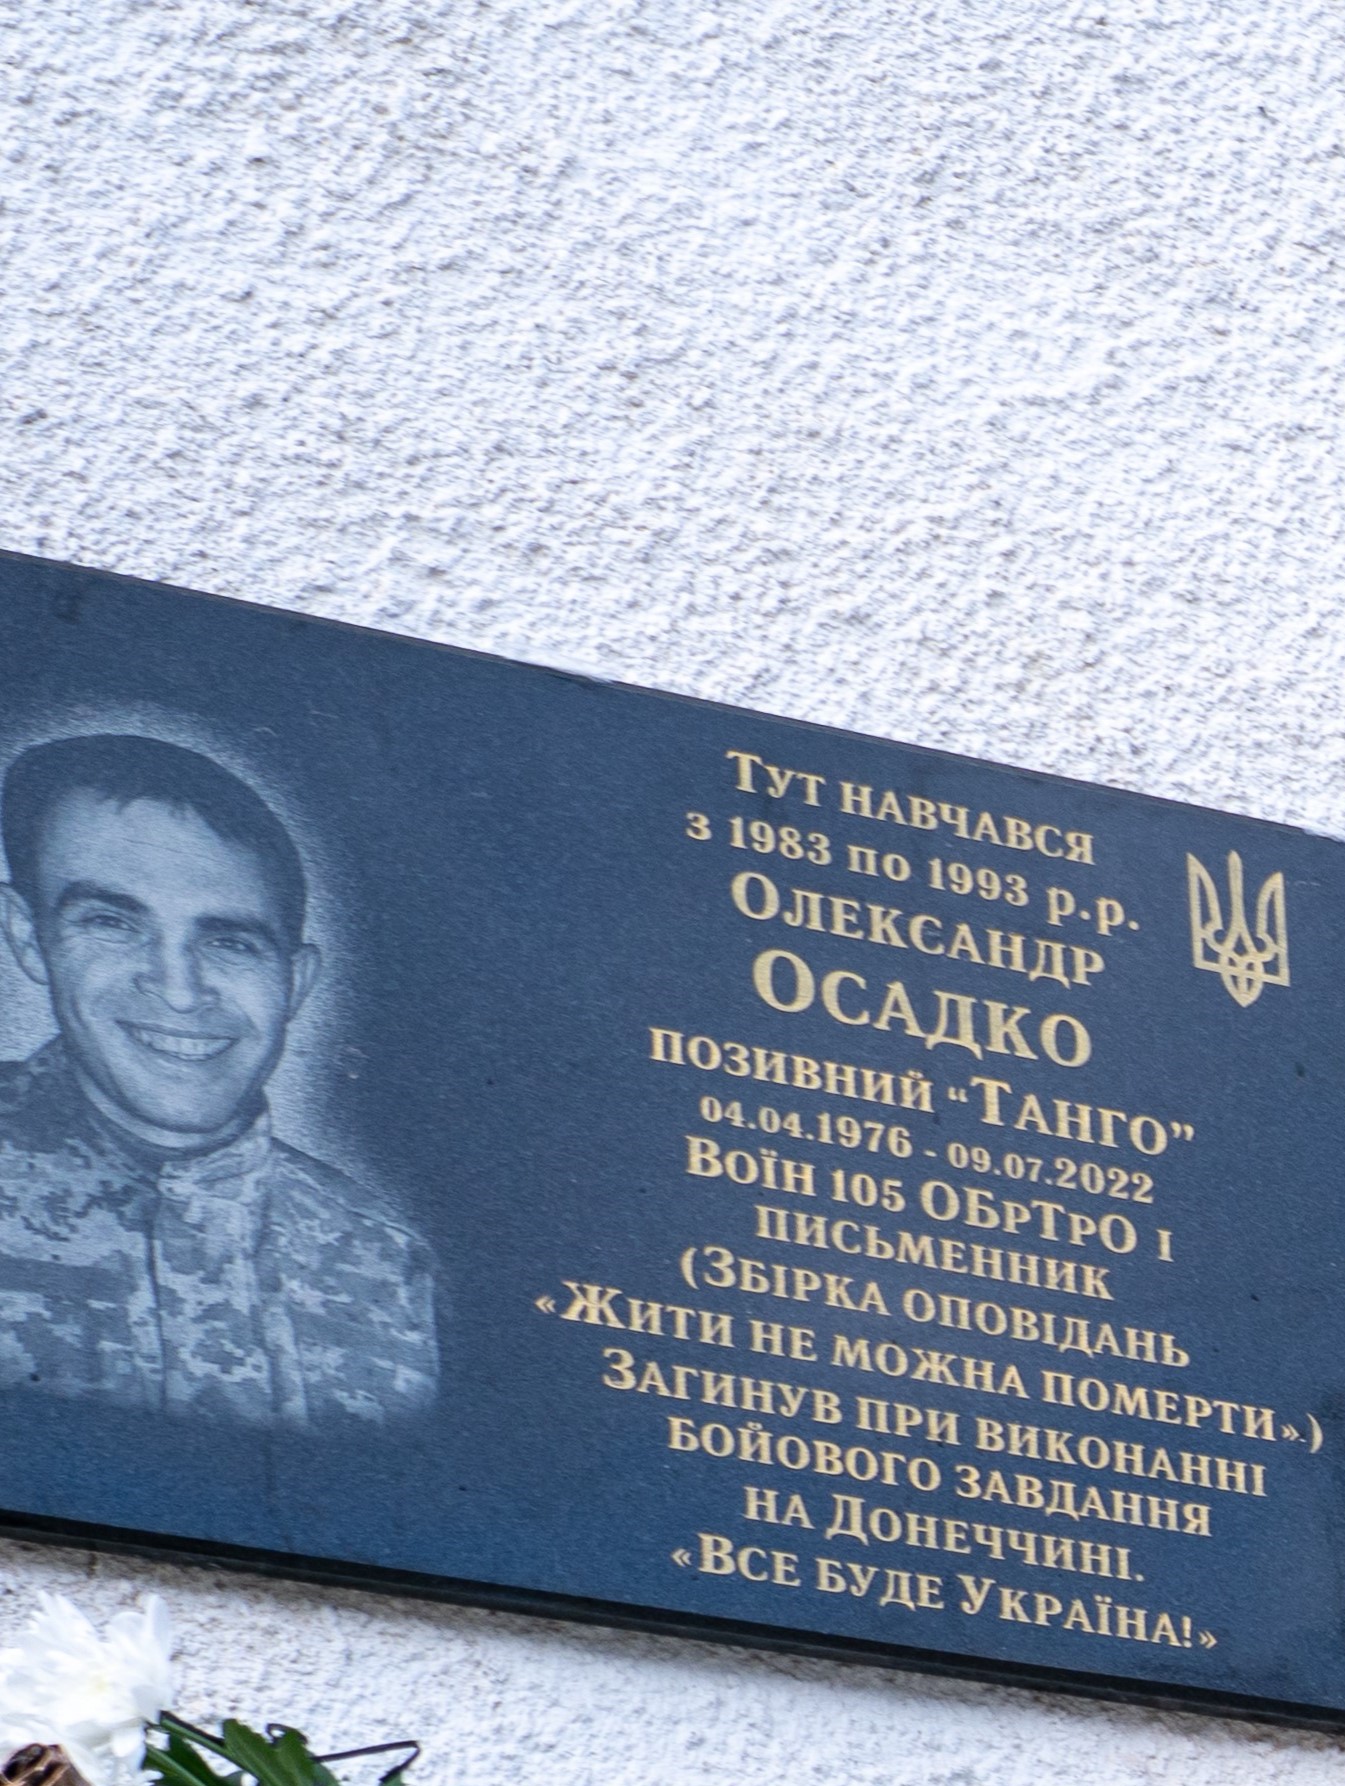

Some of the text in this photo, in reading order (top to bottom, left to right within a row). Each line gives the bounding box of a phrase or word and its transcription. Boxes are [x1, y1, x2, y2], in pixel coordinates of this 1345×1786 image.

[727, 815, 833, 866] 1983
[927, 857, 1030, 907] 1993
[1045, 886, 1140, 937] р.р.
[699, 1095, 914, 1159] 04.04.1976
[946, 1141, 1155, 1204] 09.07.2022
[830, 1168, 907, 1213] 105
